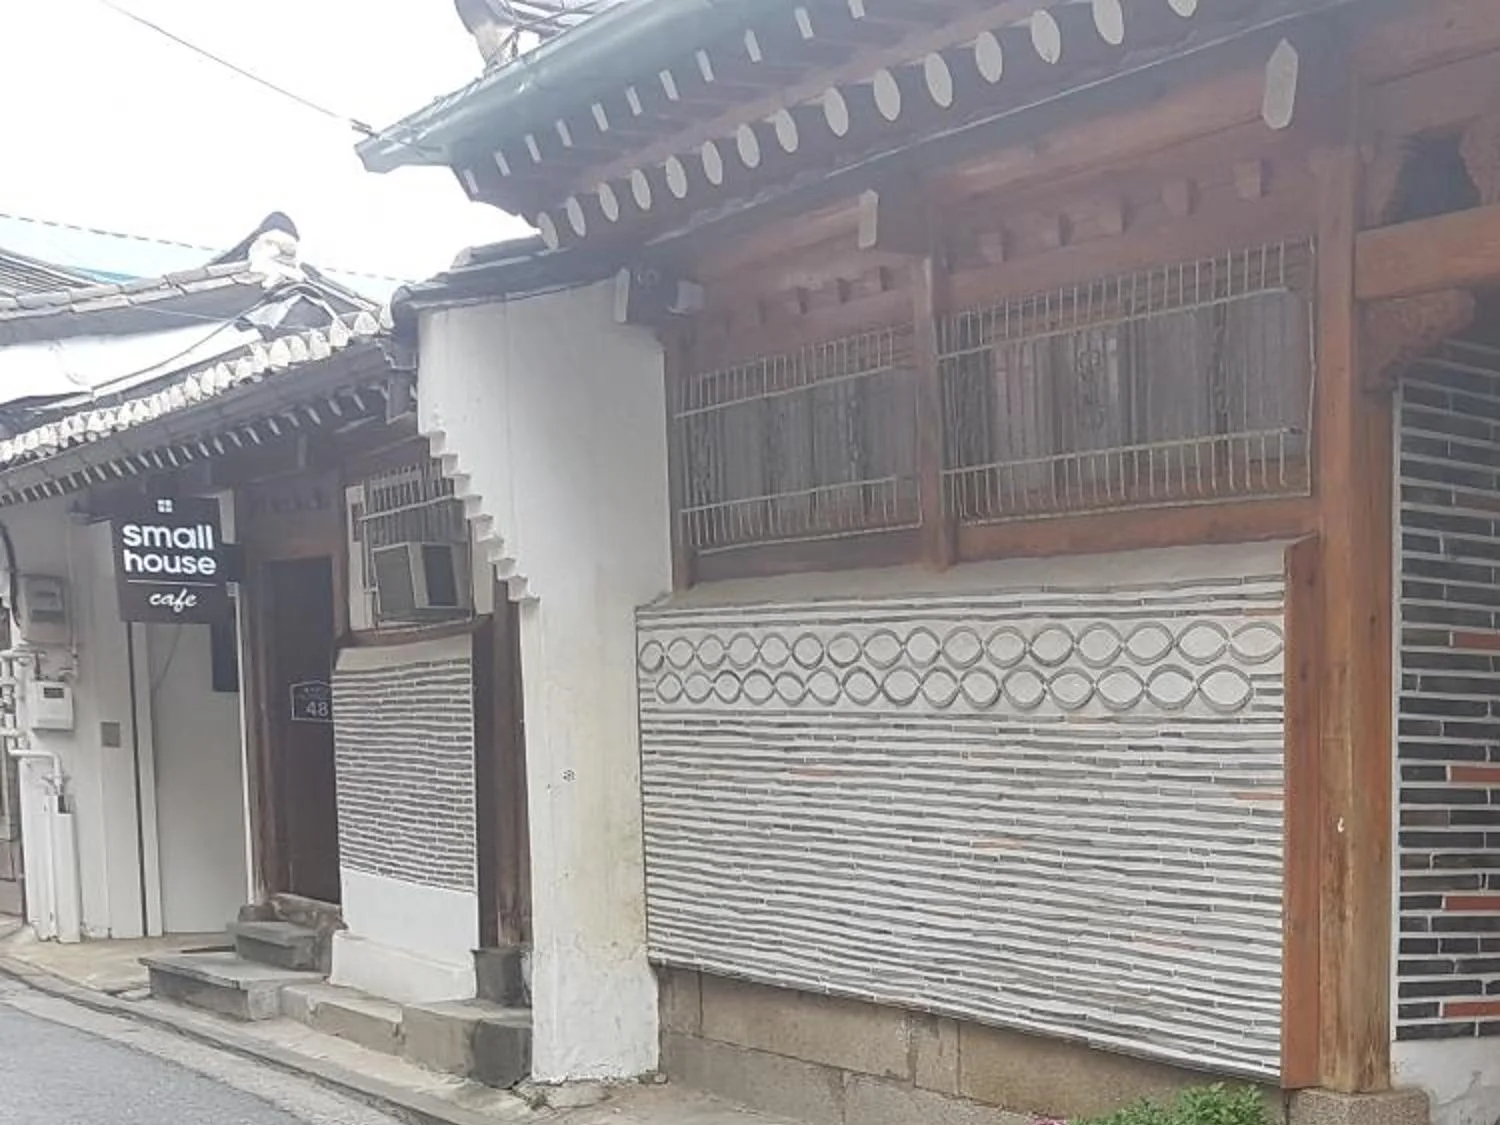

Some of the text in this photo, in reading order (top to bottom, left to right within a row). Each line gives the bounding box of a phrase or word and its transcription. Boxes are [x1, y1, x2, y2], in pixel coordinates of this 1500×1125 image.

[122, 523, 214, 550] small
[123, 549, 217, 575] house
[149, 588, 197, 612] cafe
[304, 701, 329, 717] 48
